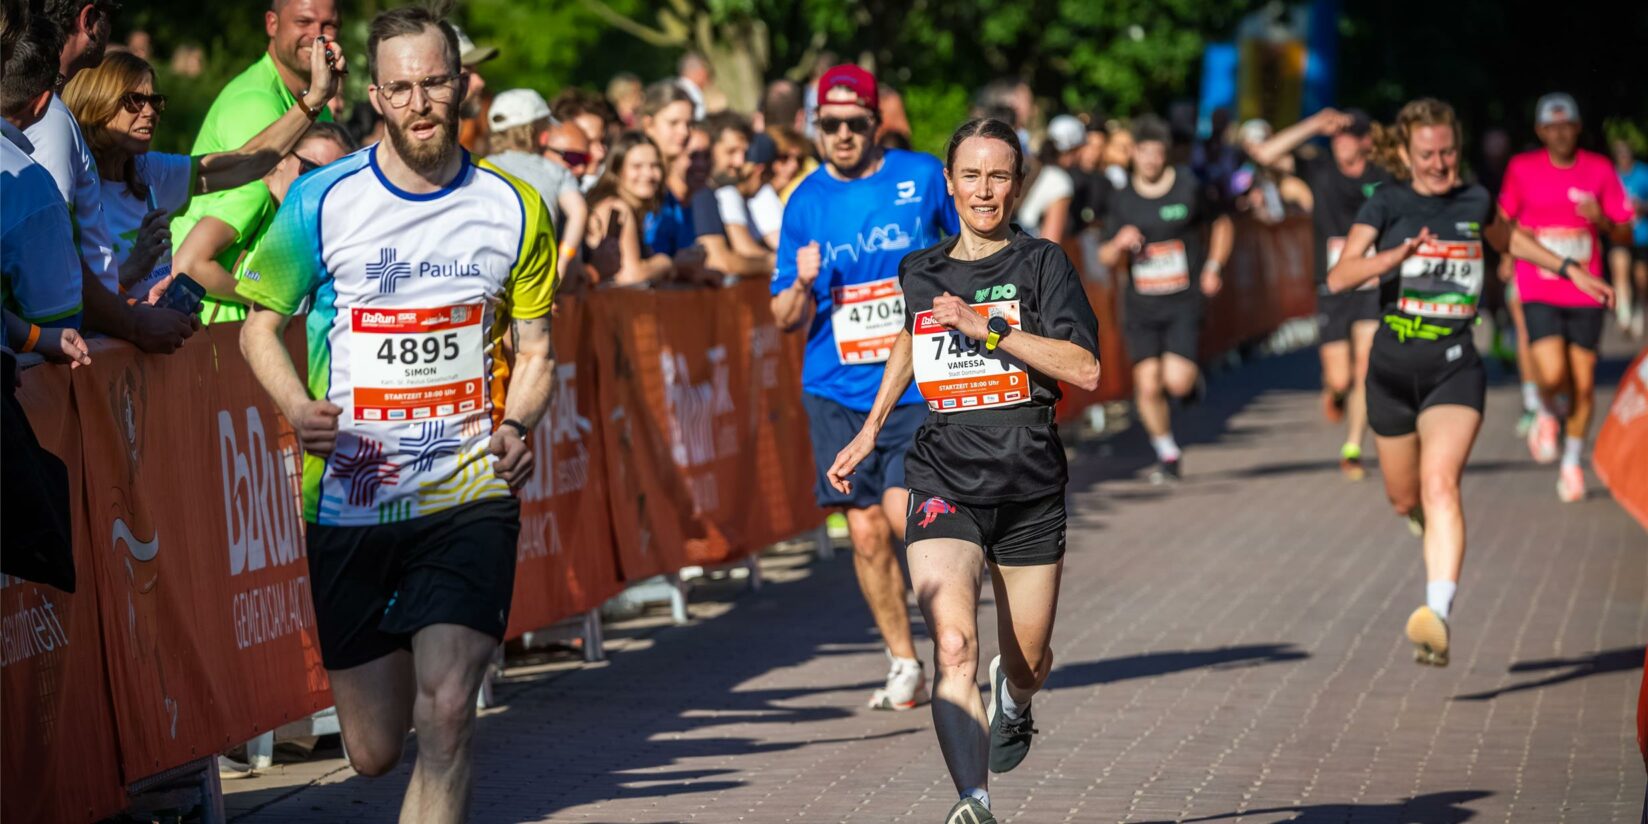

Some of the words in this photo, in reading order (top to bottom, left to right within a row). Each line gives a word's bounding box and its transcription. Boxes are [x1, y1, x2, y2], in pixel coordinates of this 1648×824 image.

[419, 259, 481, 278] Paulus
[849, 298, 902, 323] 4704
[377, 332, 460, 365] 4895
[404, 367, 437, 377] SIMON
[947, 359, 986, 370] VANESSA
[384, 393, 423, 401] STARTZEIT
[465, 382, 475, 395] D
[938, 383, 968, 392] STARTZEIT
[969, 380, 988, 388] 18:00
[1009, 375, 1019, 386] D
